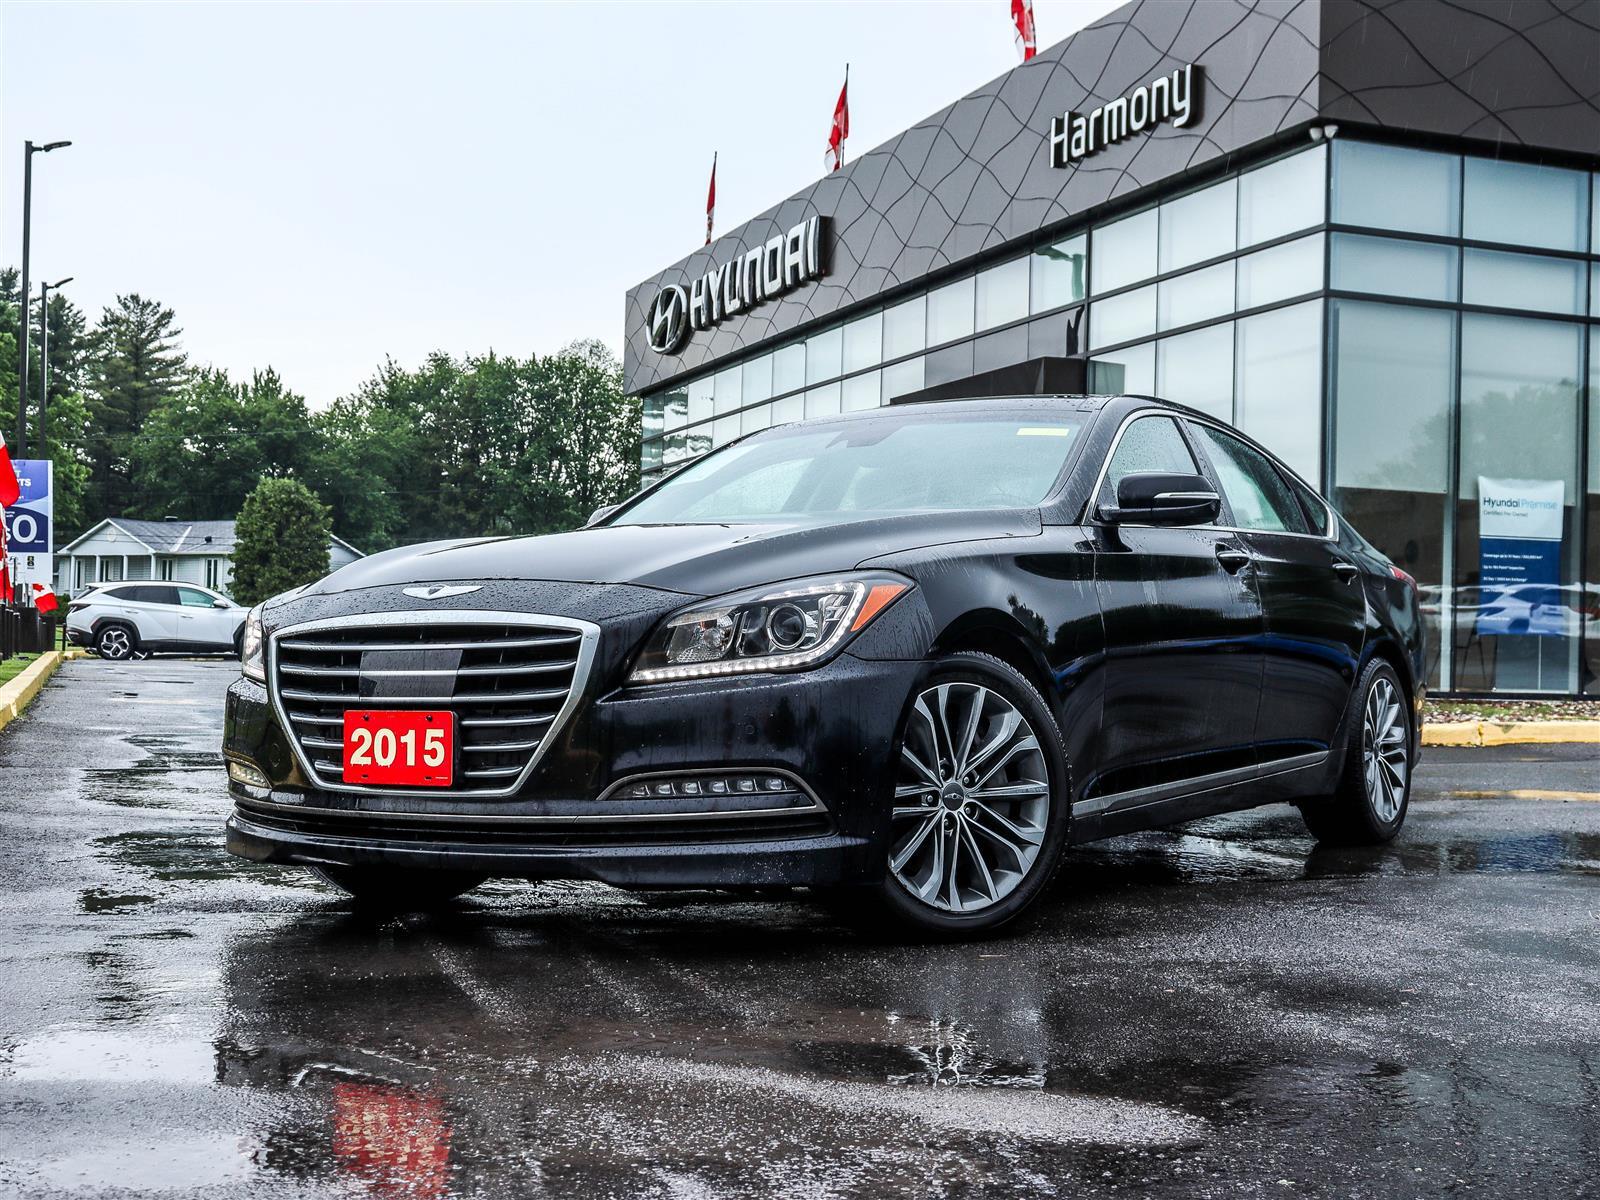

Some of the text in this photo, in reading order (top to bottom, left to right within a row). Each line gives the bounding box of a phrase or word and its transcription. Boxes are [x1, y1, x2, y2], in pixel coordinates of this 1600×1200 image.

[1050, 63, 1197, 168] Harmony
[690, 215, 821, 329] HYUNDAI
[1483, 497, 1520, 509] Hyundai
[350, 727, 445, 767] 2015
